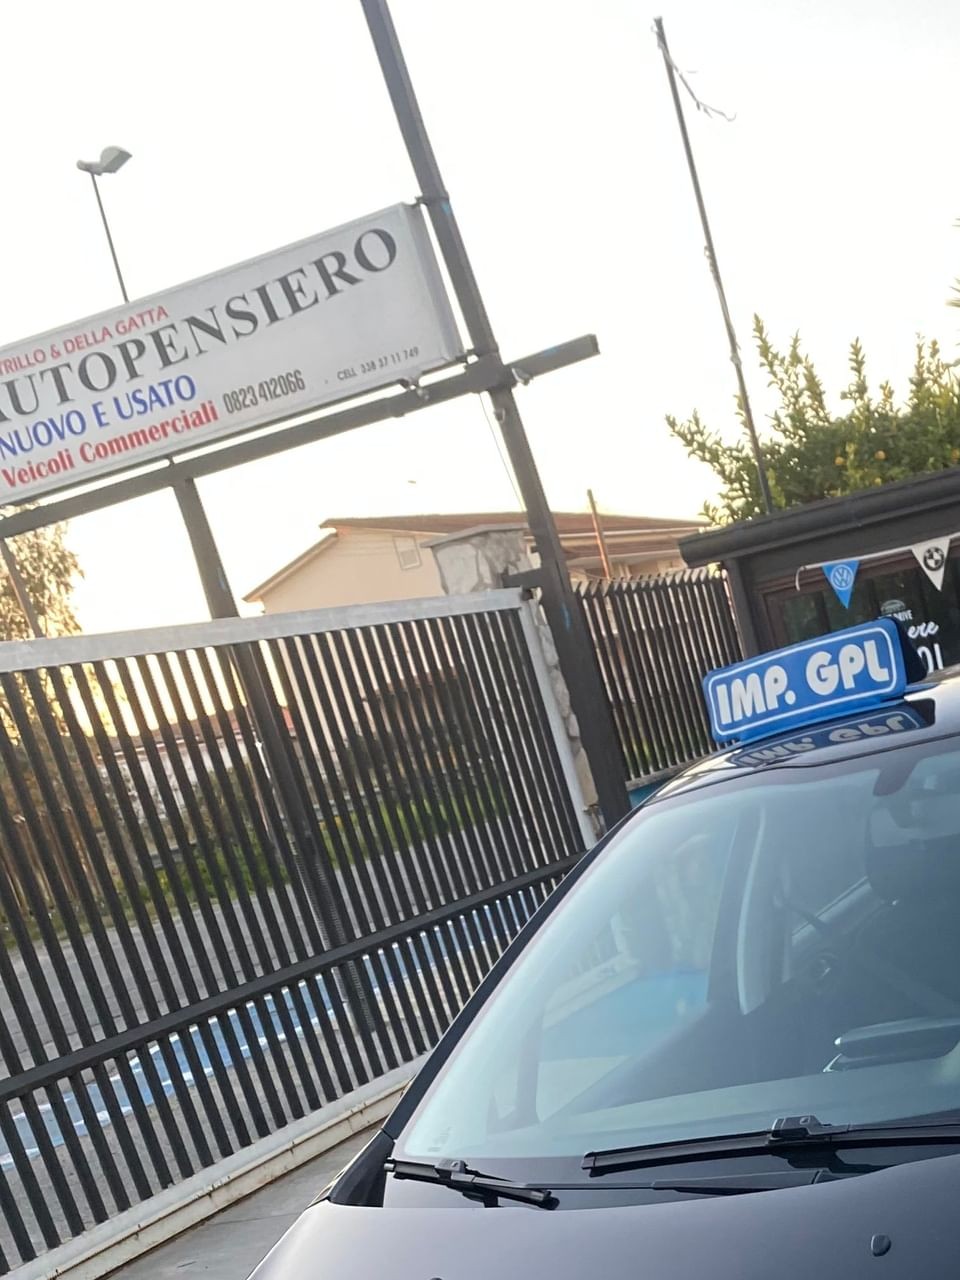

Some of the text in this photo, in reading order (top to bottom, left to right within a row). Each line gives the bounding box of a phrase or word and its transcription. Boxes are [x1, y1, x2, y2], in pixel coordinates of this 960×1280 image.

[0, 227, 398, 423] UTOPENSIERO
[50, 343, 62, 360] &
[63, 325, 113, 354] DELLA
[115, 304, 169, 335] GATTA
[0, 374, 197, 461] NUOVO E USATO
[1, 400, 220, 488] Veicoli Commerciali
[715, 639, 890, 726] IMP. GPL
